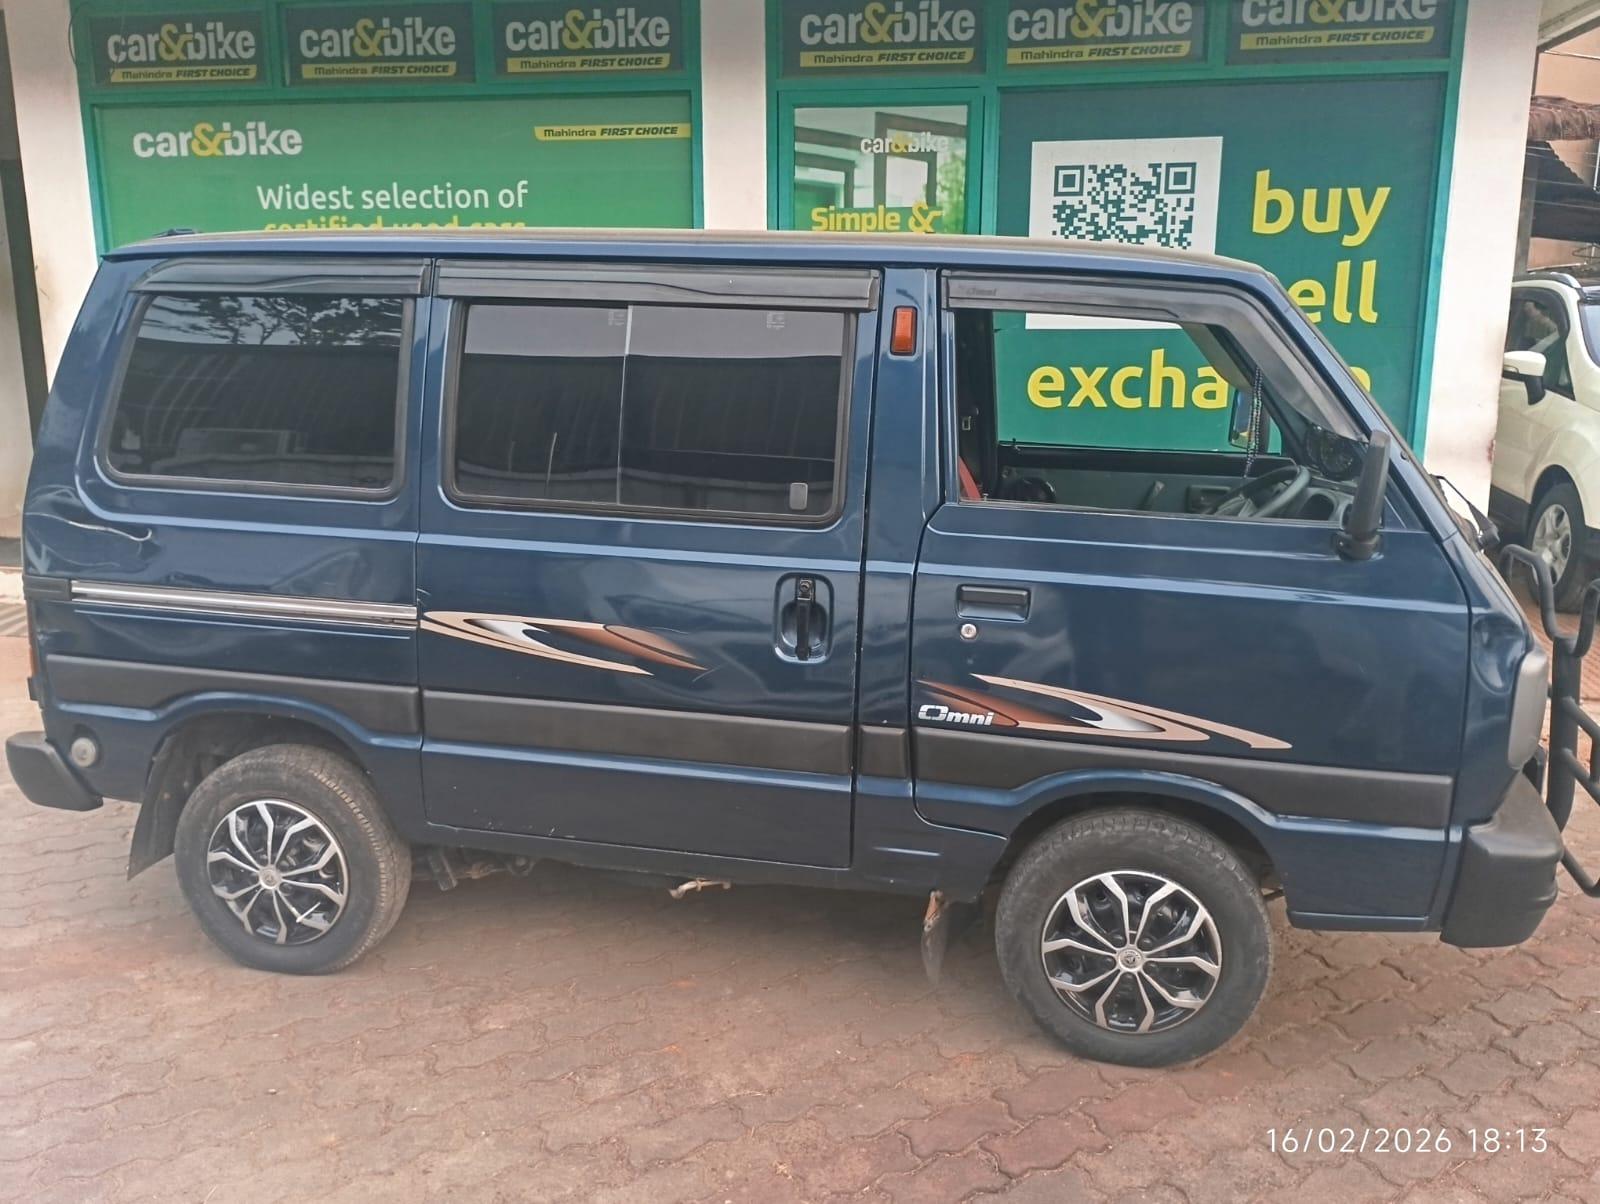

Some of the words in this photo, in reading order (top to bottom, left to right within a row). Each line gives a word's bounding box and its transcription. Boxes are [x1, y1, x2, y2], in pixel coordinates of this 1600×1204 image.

[505, 7, 671, 51] car&bike
[800, 0, 976, 46] car&bike
[1007, 0, 1193, 41] car&bike
[107, 21, 256, 63] car&bike
[300, 16, 456, 59] car&bike
[1020, 48, 1084, 61] Mahindra
[1087, 46, 1130, 58] FIRST
[1130, 43, 1183, 56] CHOICE
[1255, 34, 1323, 46] Mahindra
[1326, 31, 1370, 43] FIRST
[1371, 28, 1425, 42] CHOICE
[314, 65, 368, 76] Mahindra
[371, 65, 404, 75] FIRST
[406, 63, 450, 75] CHOICE
[519, 58, 577, 70] Mahindra
[580, 57, 617, 68] FIRST
[617, 55, 663, 67] CHOICE
[813, 52, 874, 64] Mahindra
[877, 52, 917, 63] FIRST
[917, 50, 967, 62] CHOICE
[121, 69, 173, 80] Mahindra
[176, 68, 209, 79] FIRST
[209, 67, 251, 78] CHOICE
[132, 120, 303, 158] car&bike
[543, 127, 597, 138] Mahindra
[600, 126, 635, 137] FIRST
[635, 125, 679, 136] CHOICE
[860, 132, 949, 154] car&bike
[256, 182, 355, 211] Widest
[360, 181, 490, 210] selection
[497, 179, 529, 209] of
[1252, 169, 1391, 247] buy
[811, 203, 901, 233] Simple
[907, 200, 945, 233] &
[1287, 259, 1378, 324] ell
[918, 704, 994, 726] Omni
